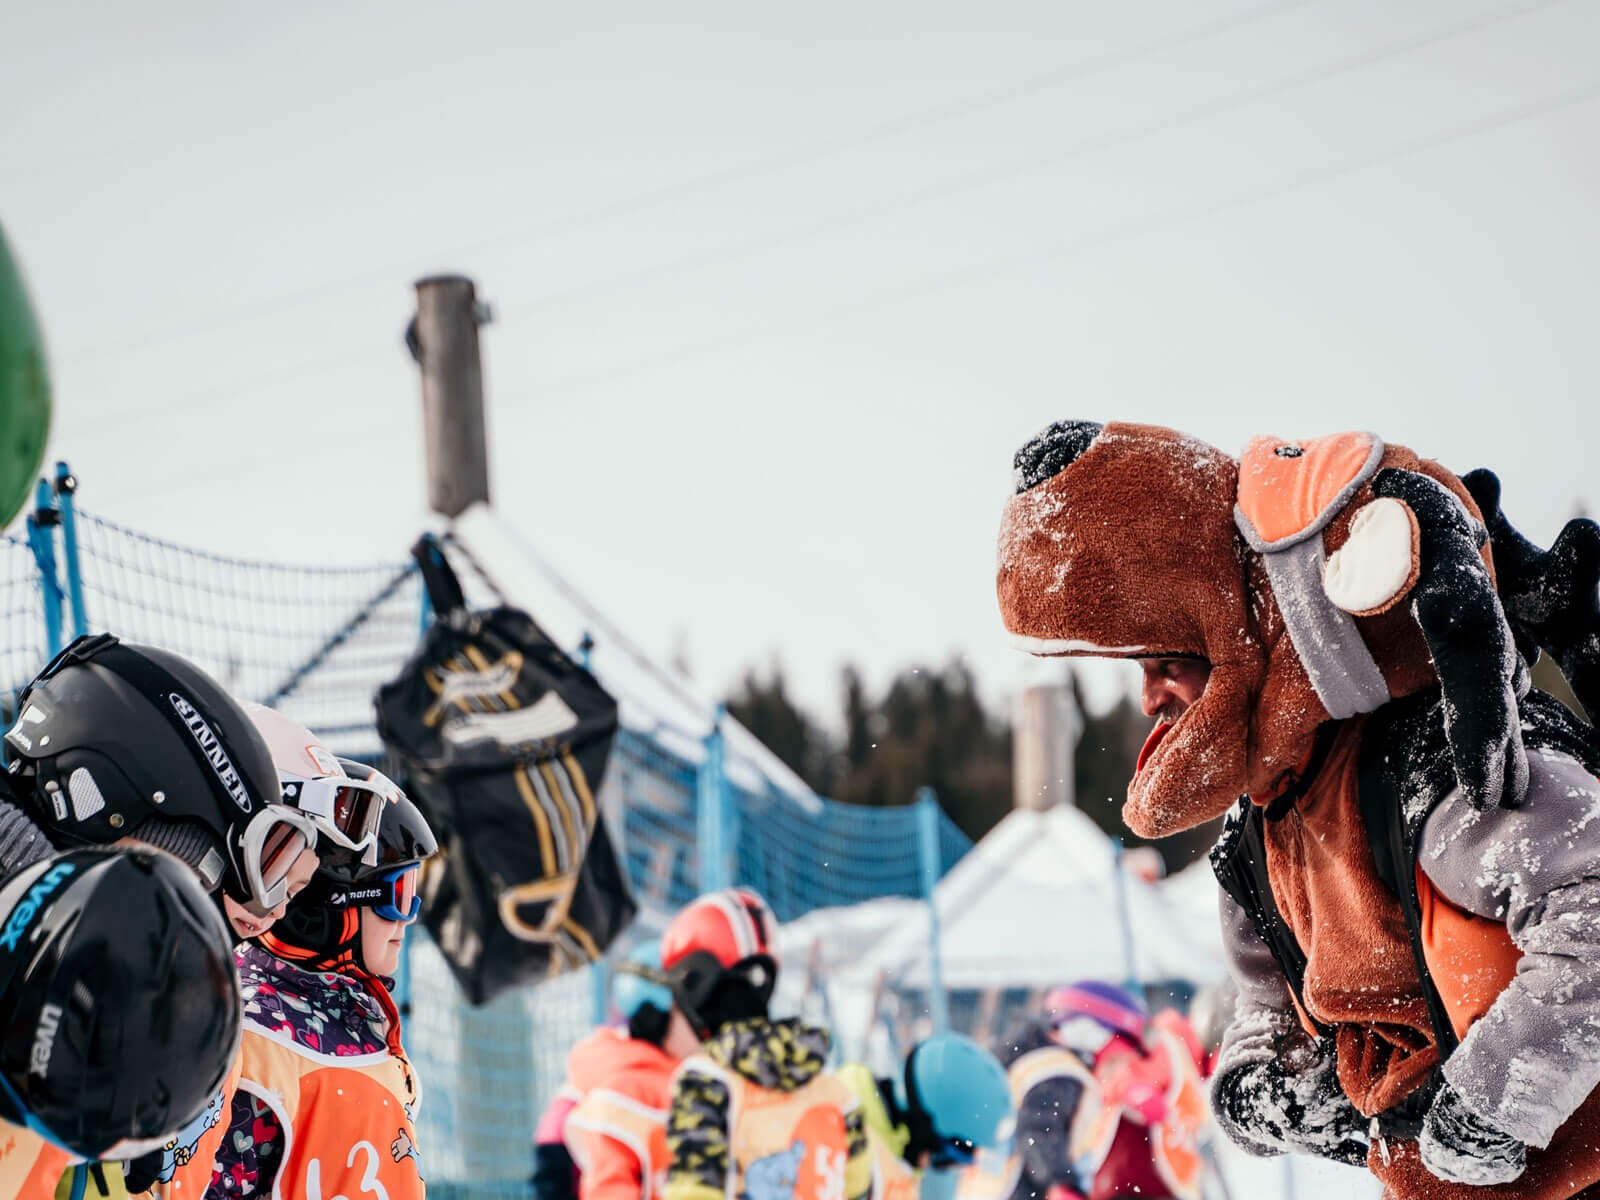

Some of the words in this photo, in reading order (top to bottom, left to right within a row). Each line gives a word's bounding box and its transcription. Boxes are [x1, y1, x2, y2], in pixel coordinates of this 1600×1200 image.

[175, 700, 247, 806] SINNER
[0, 863, 76, 953] uvex
[30, 1003, 62, 1079] uvex
